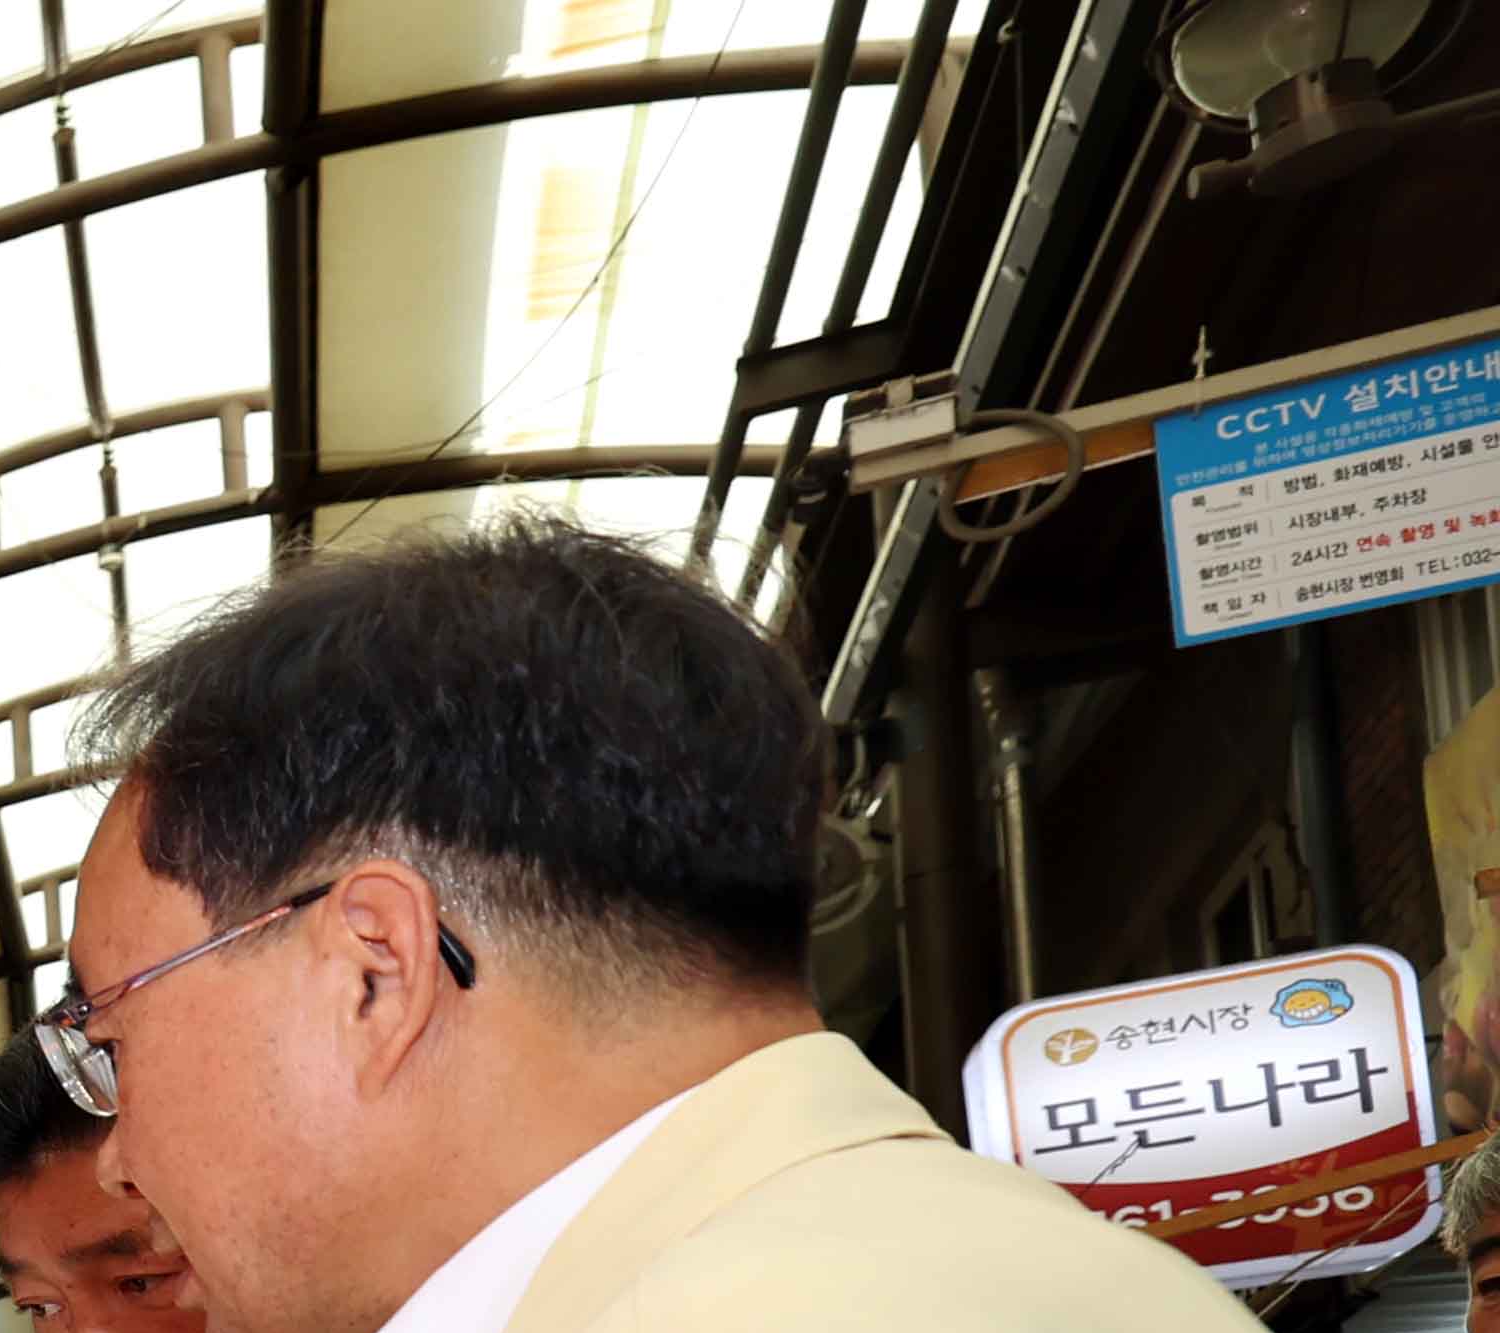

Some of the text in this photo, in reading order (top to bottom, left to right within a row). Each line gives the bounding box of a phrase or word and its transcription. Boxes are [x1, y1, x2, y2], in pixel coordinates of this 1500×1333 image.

[1216, 349, 1500, 439] CCTV 설치안내
[1421, 438, 1473, 462] 시설물
[1373, 488, 1427, 512] 주차장
[1200, 555, 1262, 581] 촬영시간
[1292, 542, 1348, 567] 24시간
[1295, 577, 1354, 603] 송현시장
[1104, 1002, 1253, 1050] 송현시장
[1035, 1048, 1388, 1156] 모든나라
